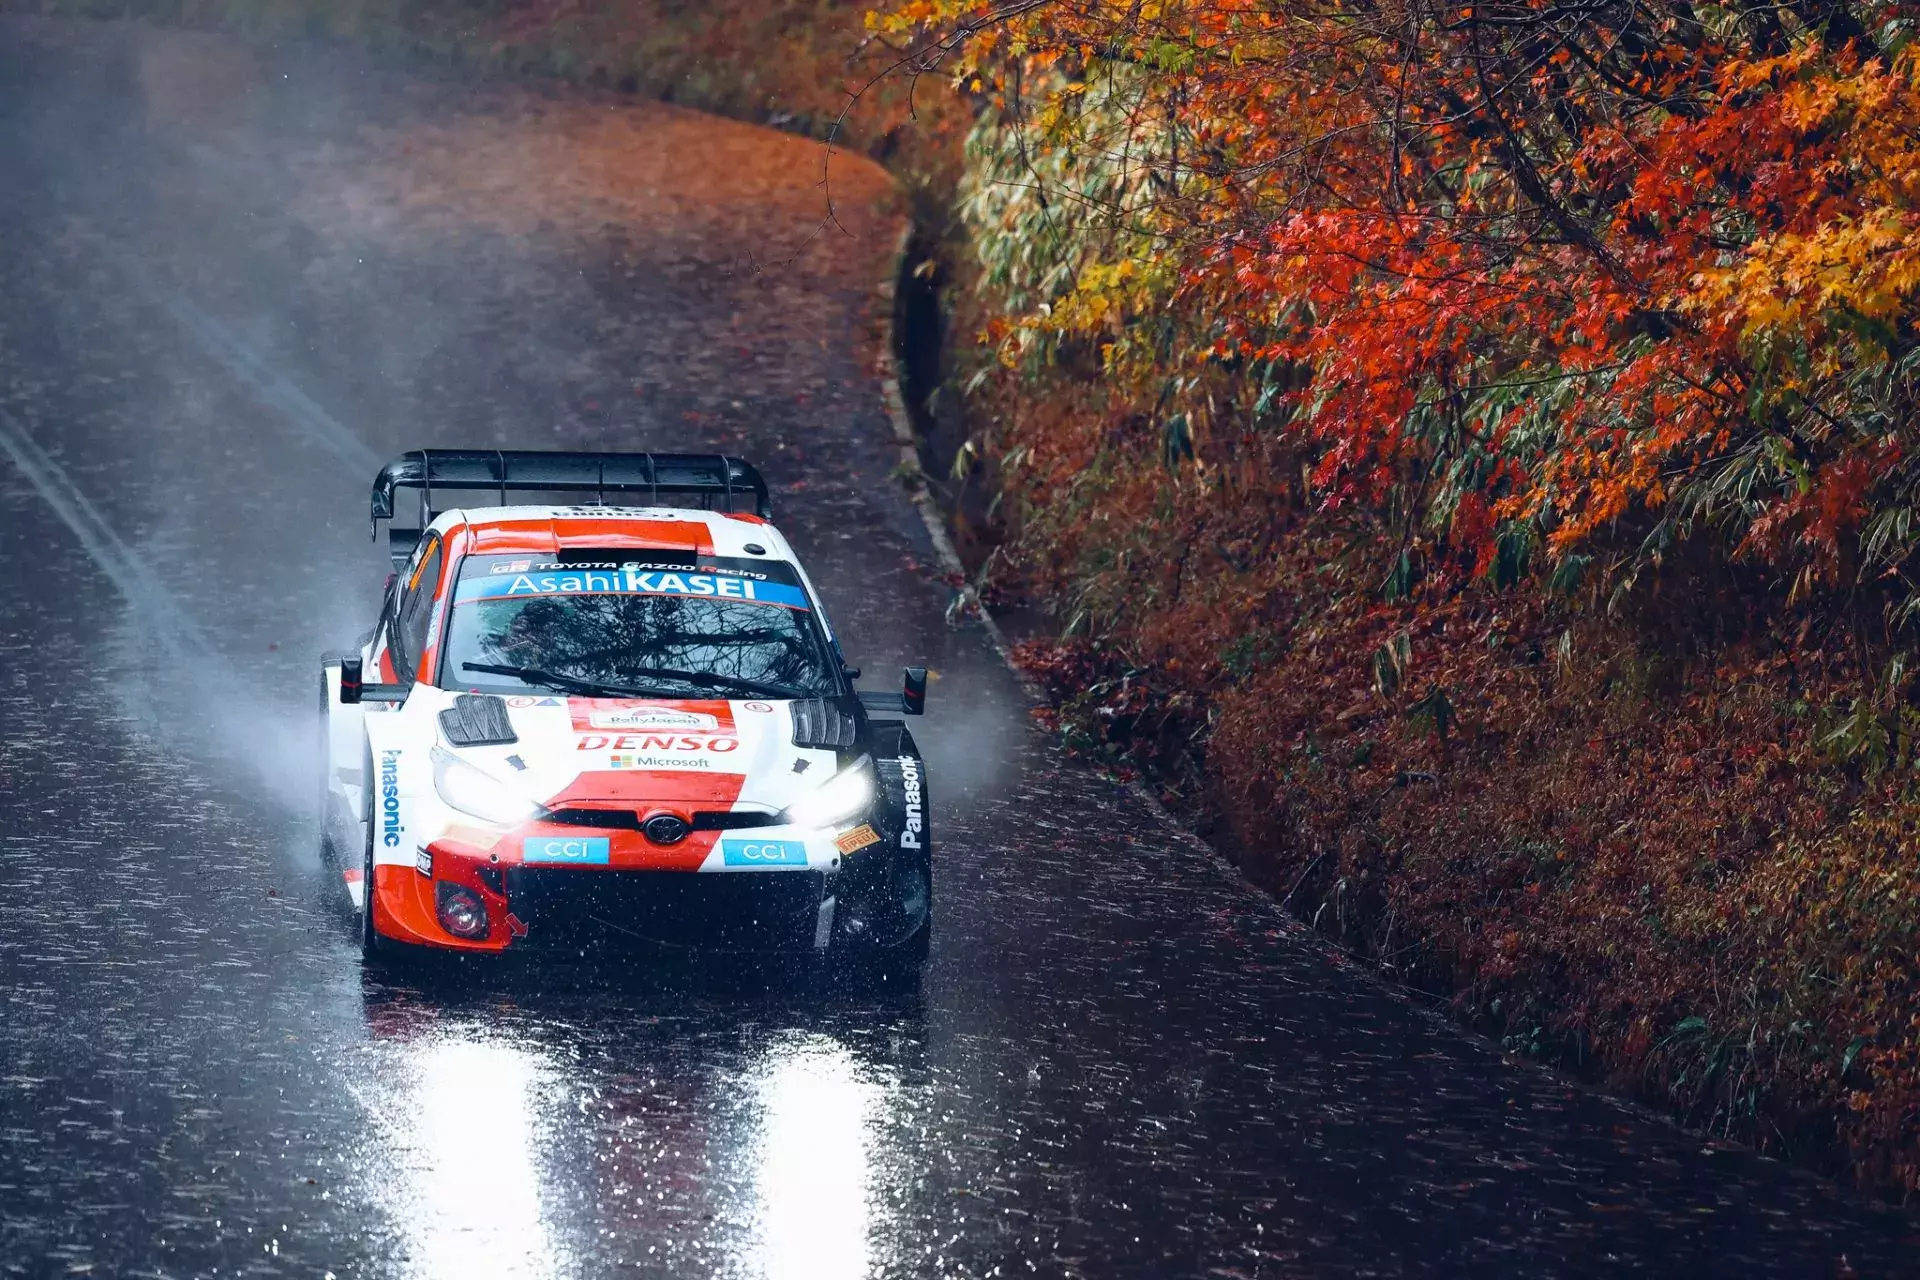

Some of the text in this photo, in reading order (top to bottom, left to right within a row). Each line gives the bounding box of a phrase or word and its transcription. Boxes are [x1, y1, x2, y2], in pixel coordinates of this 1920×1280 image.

[536, 562, 617, 570] TOYOTA
[622, 561, 696, 571] GAZOO
[700, 565, 767, 580] Racing
[577, 736, 739, 753] DENSO
[637, 756, 710, 768] Microsoft
[382, 749, 405, 848] Panasonic
